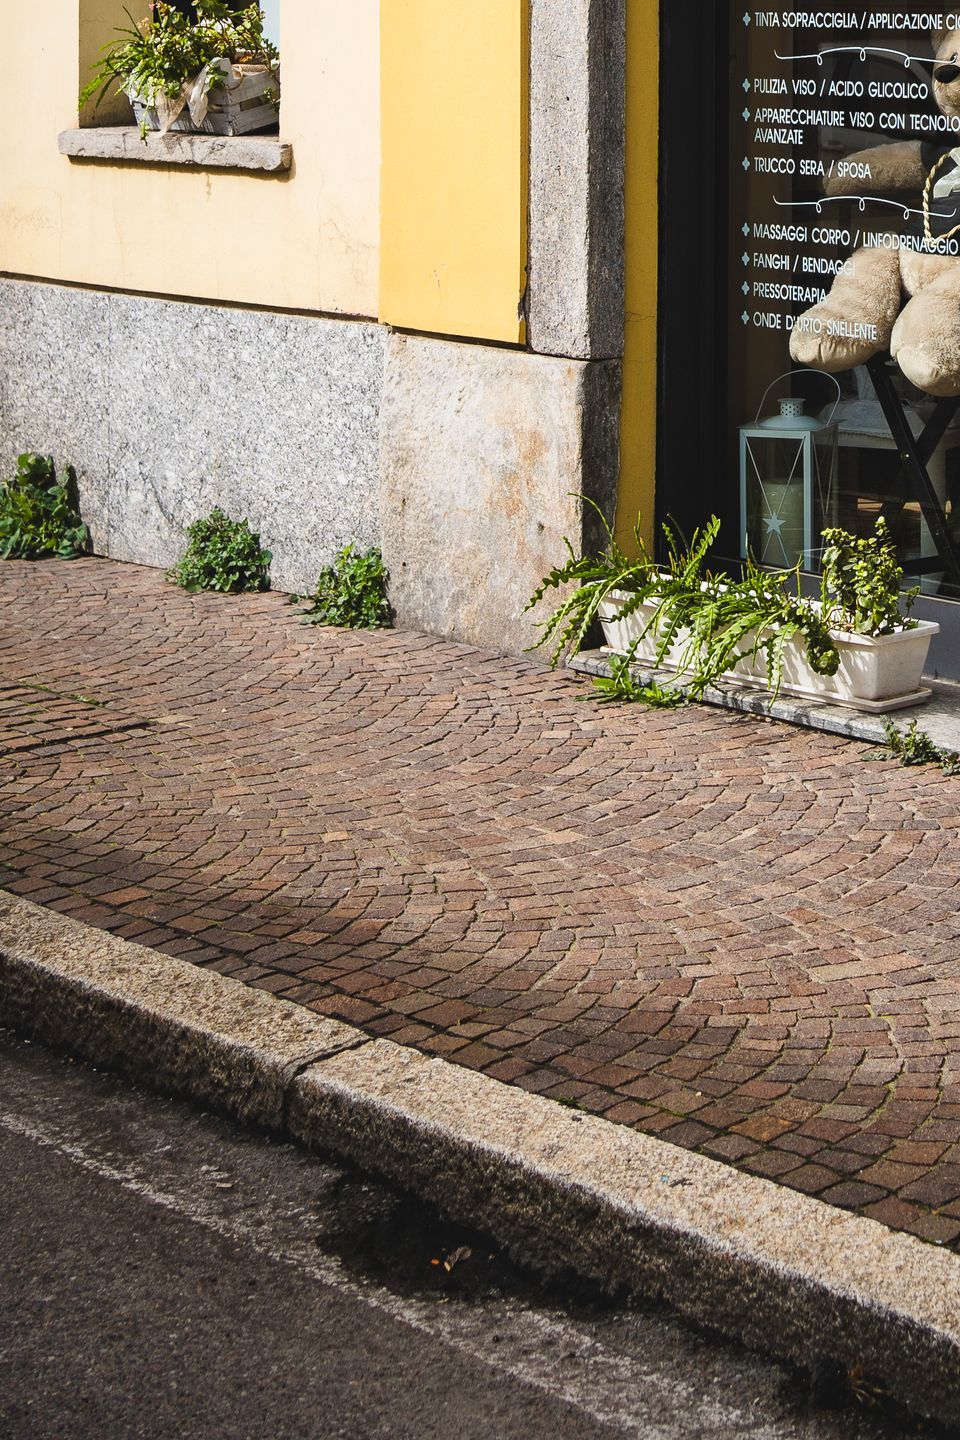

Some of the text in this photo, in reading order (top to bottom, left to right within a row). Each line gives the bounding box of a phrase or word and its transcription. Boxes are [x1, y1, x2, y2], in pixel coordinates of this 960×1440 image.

[755, 12, 779, 27] TINTA
[782, 12, 858, 29] SOPRACCIGLIA
[868, 13, 942, 30] APPLICAZIONE
[754, 78, 787, 95] PULIZIA
[792, 79, 816, 96] VISO
[828, 80, 863, 97] ACIDO
[868, 81, 928, 100] GLICOLICO
[754, 108, 844, 127] APPARECCHIATURE
[850, 111, 874, 128] VISO
[879, 112, 905, 129] CON
[754, 128, 803, 144] AVANZATE
[754, 157, 795, 174] TRUCCO
[800, 159, 824, 176] SERA
[837, 161, 871, 178] SPOSA
[754, 223, 807, 242] MASSAGGI
[812, 228, 850, 246] CORPO
[863, 231, 958, 255] LINFODRENAGGIO
[754, 252, 790, 270] FANGHI
[802, 257, 855, 276] BENDAGGI
[754, 282, 828, 304] PRESSOTERAPIA
[754, 312, 877, 340] ONDE D'URTO SNELLENTE
